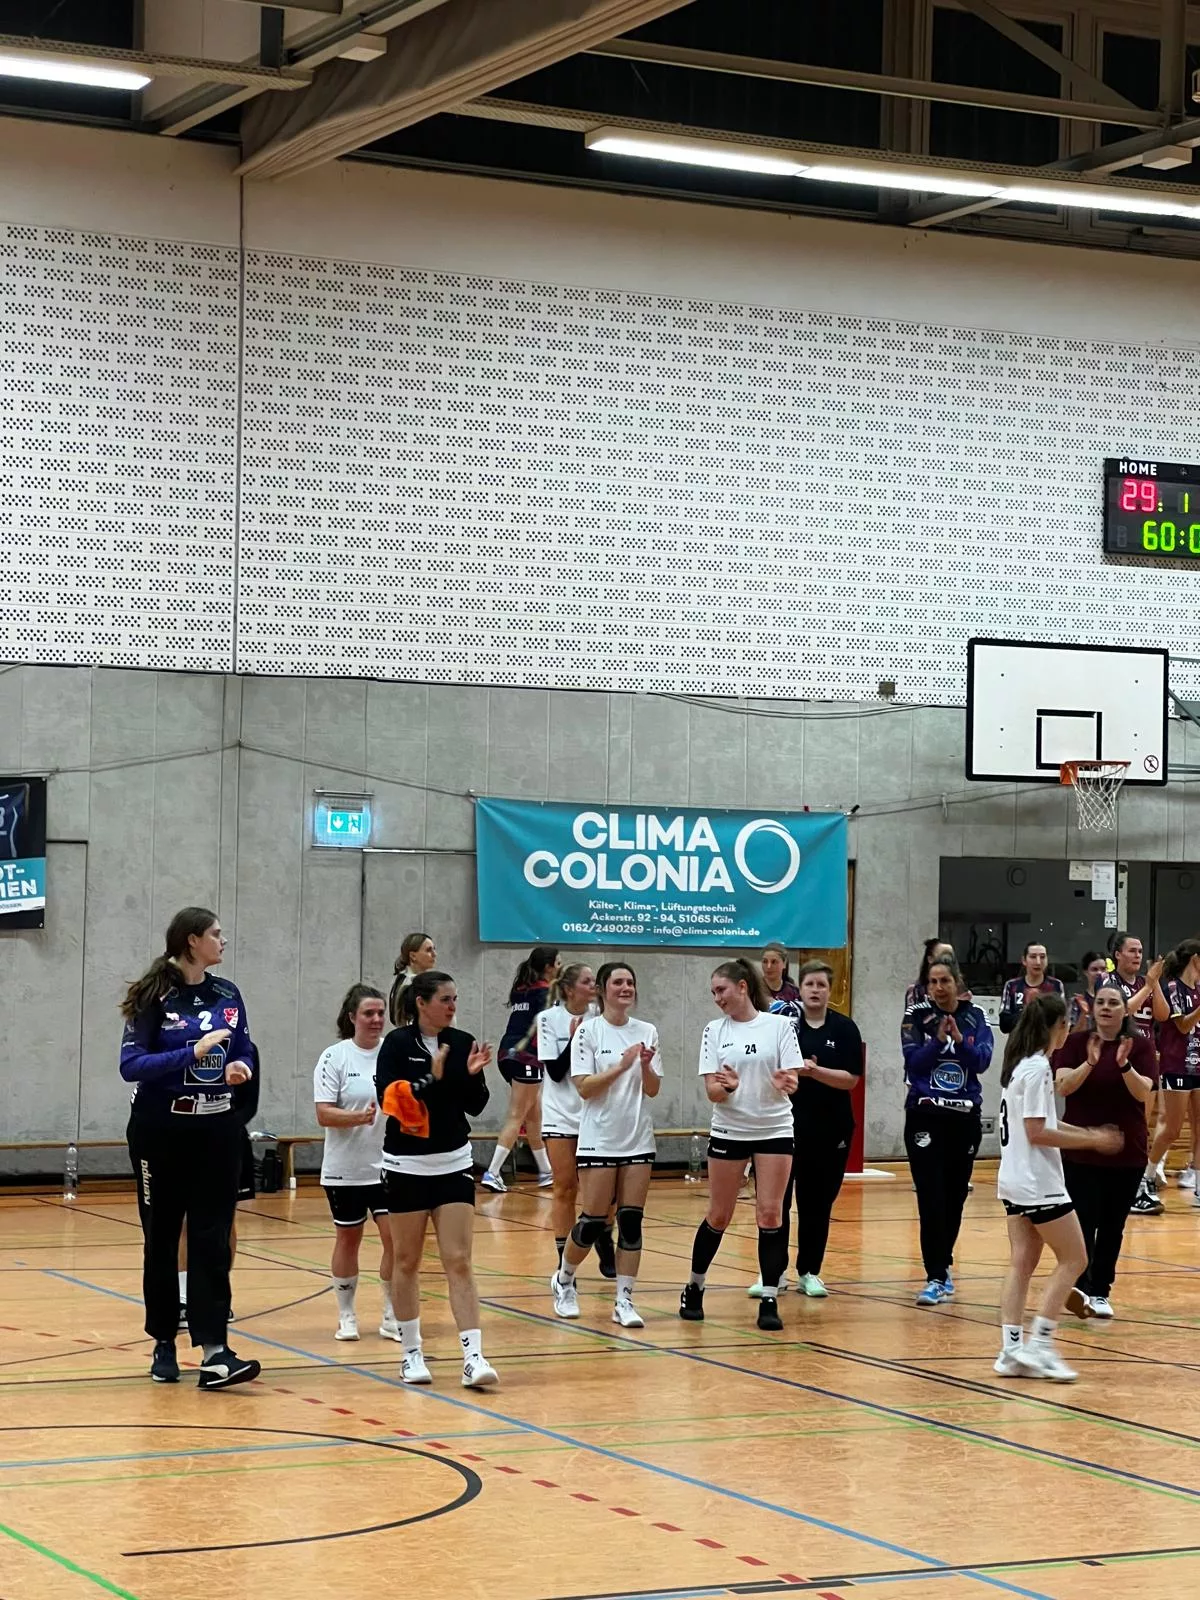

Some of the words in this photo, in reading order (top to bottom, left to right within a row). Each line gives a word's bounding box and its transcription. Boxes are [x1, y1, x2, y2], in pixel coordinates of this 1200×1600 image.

[1119, 461, 1157, 476] HOME
[572, 811, 721, 853] CLIMA
[0, 863, 25, 881] T-
[523, 850, 735, 893] COLONIA
[588, 900, 622, 911] Kälte-,
[623, 901, 659, 912] Klima-,
[661, 902, 737, 914] Lüftungstechnik
[590, 912, 635, 922] Ackerstr.
[637, 913, 651, 922] 92
[660, 914, 676, 924] 94,
[678, 914, 711, 923] 51065
[713, 915, 734, 924] Köln
[562, 923, 644, 933] 0162/2490269
[653, 926, 760, 937] info@clima-colonia.de
[198, 1010, 213, 1031] 2
[745, 1043, 757, 1055] 24
